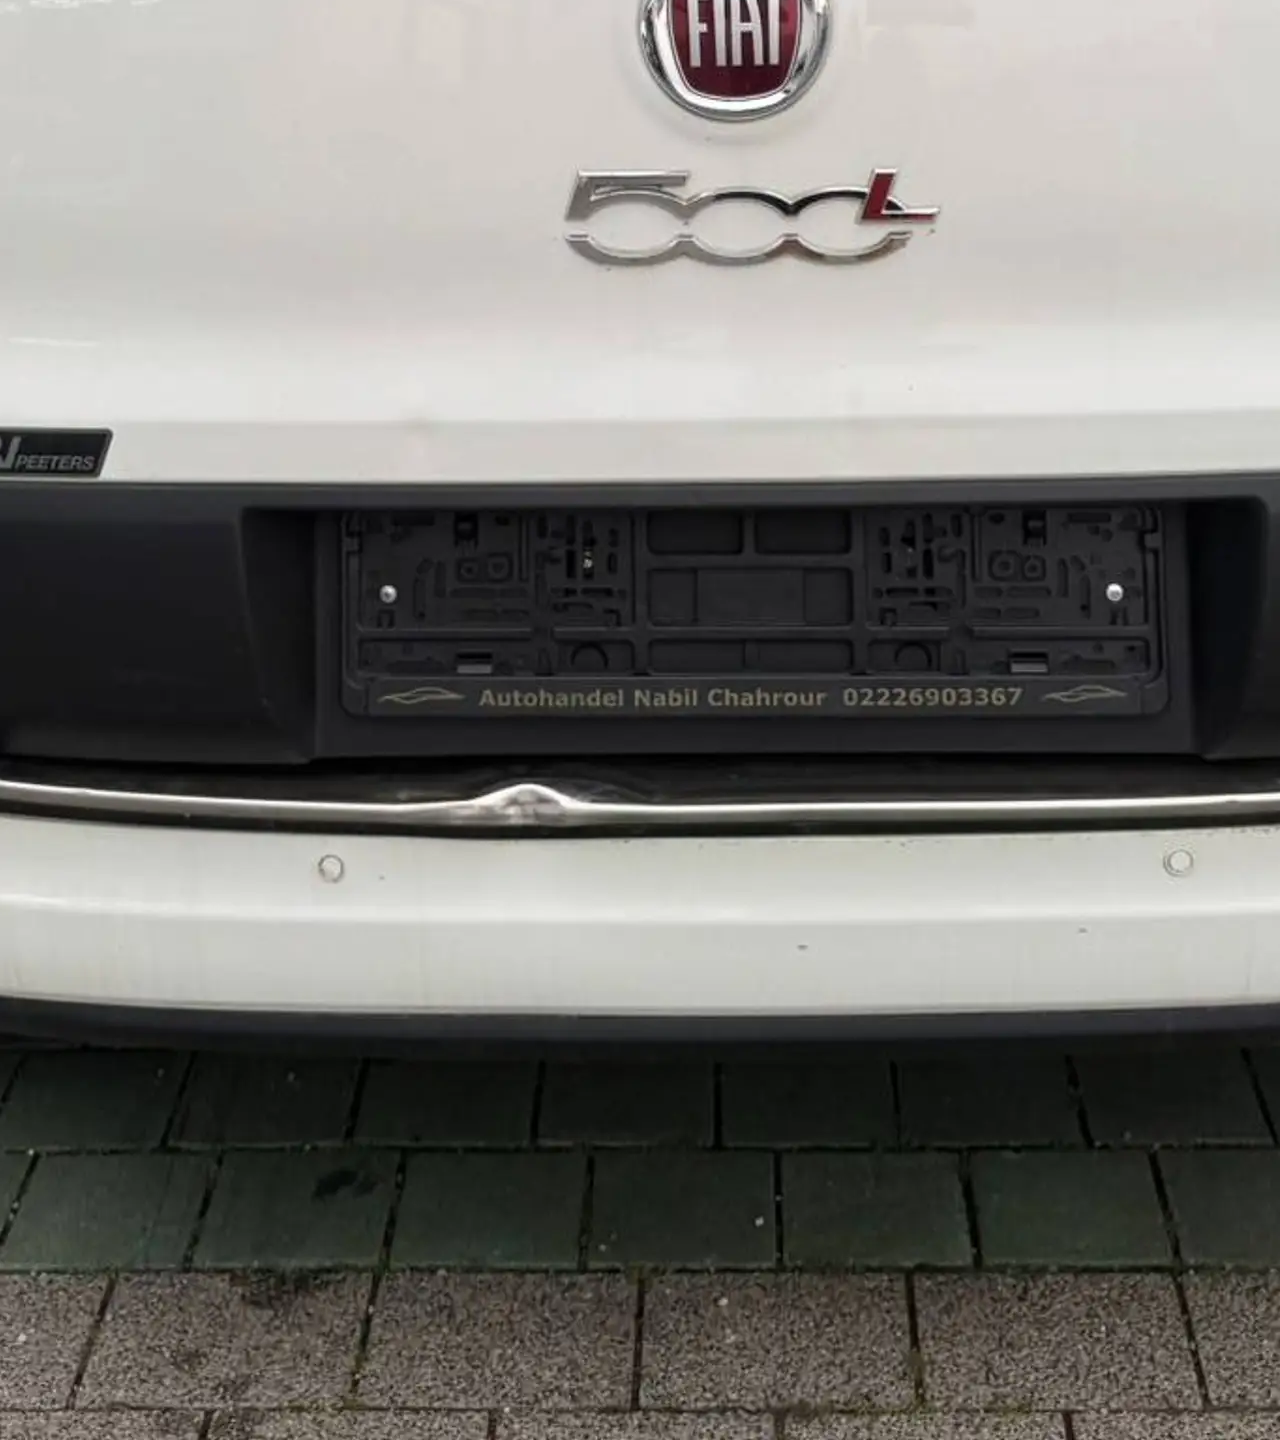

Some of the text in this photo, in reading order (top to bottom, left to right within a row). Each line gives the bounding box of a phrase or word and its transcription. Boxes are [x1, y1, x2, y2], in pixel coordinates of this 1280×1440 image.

[565, 168, 940, 266] 500L
[16, 455, 95, 471] PEETERS
[478, 687, 1023, 707] Autohandel Nabil Chahrour 02226903367
